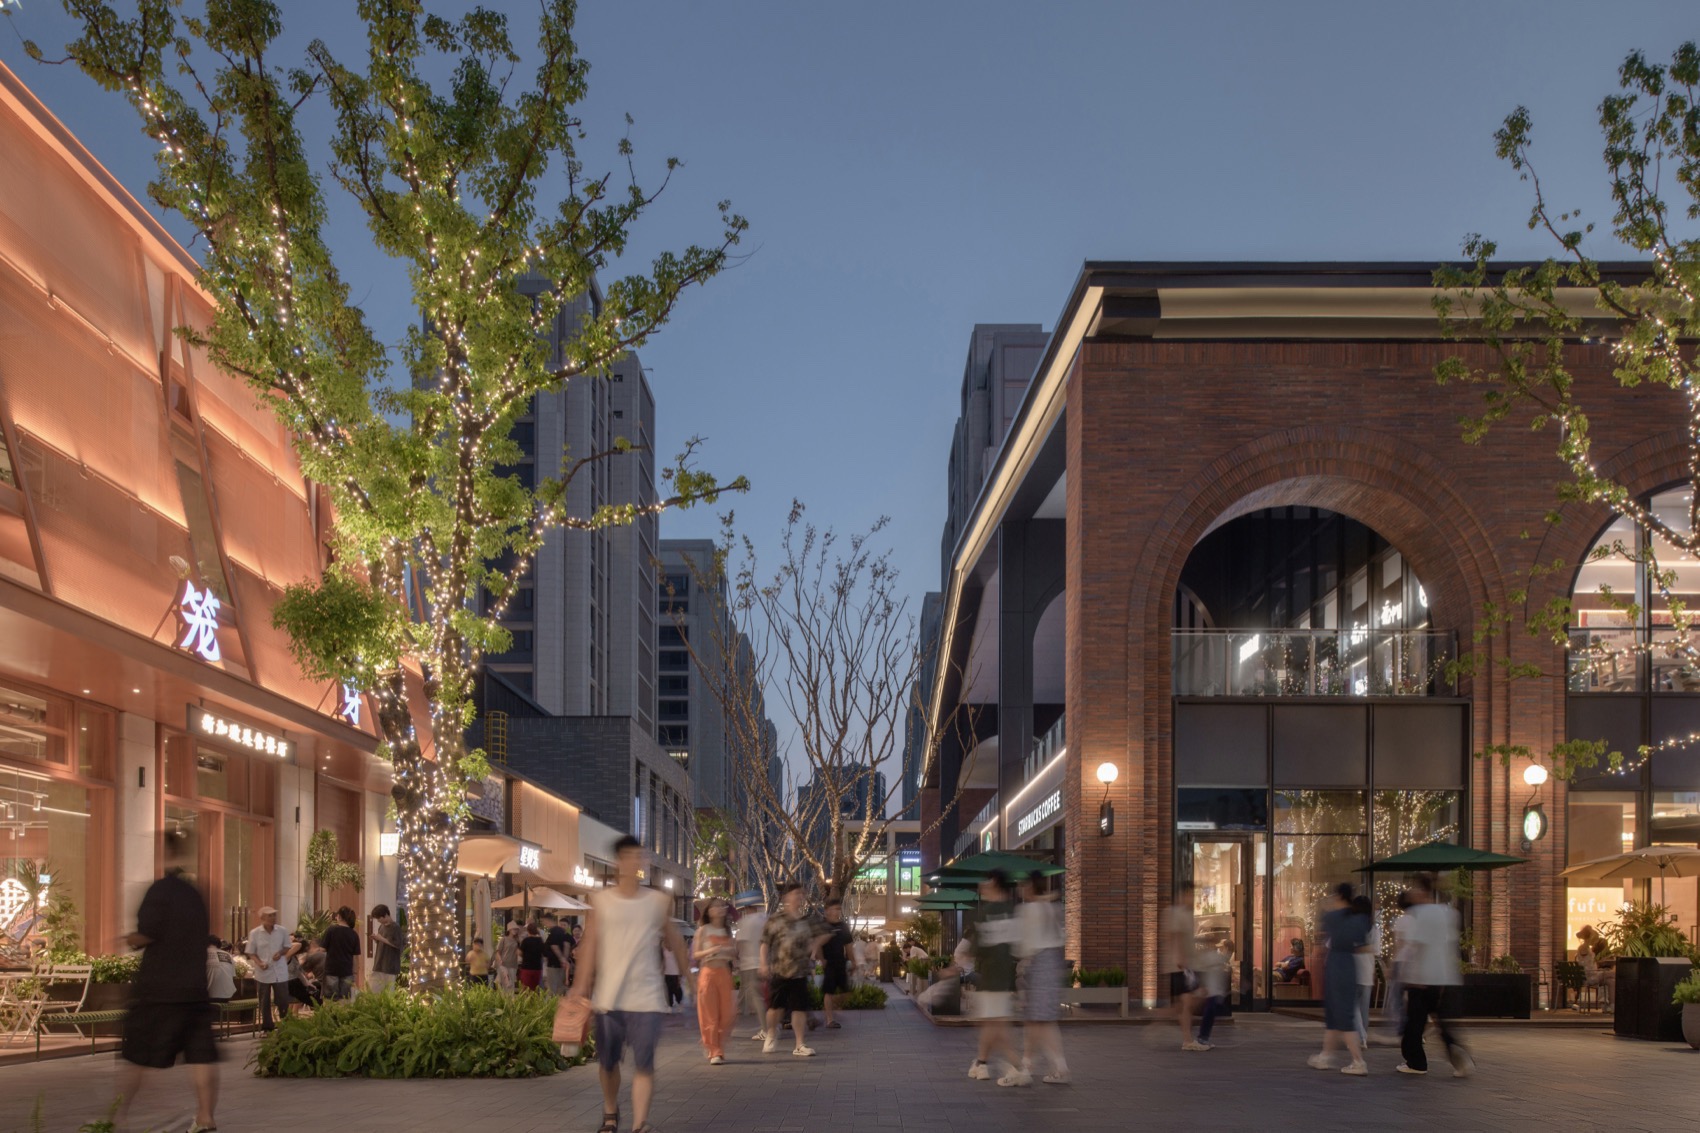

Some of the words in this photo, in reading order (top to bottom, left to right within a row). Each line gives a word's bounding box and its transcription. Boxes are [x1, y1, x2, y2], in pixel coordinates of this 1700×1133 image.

[1018, 804, 1042, 837] STARBUCKS
[1041, 790, 1060, 820] COFFEE
[1568, 897, 1607, 913] fufu
